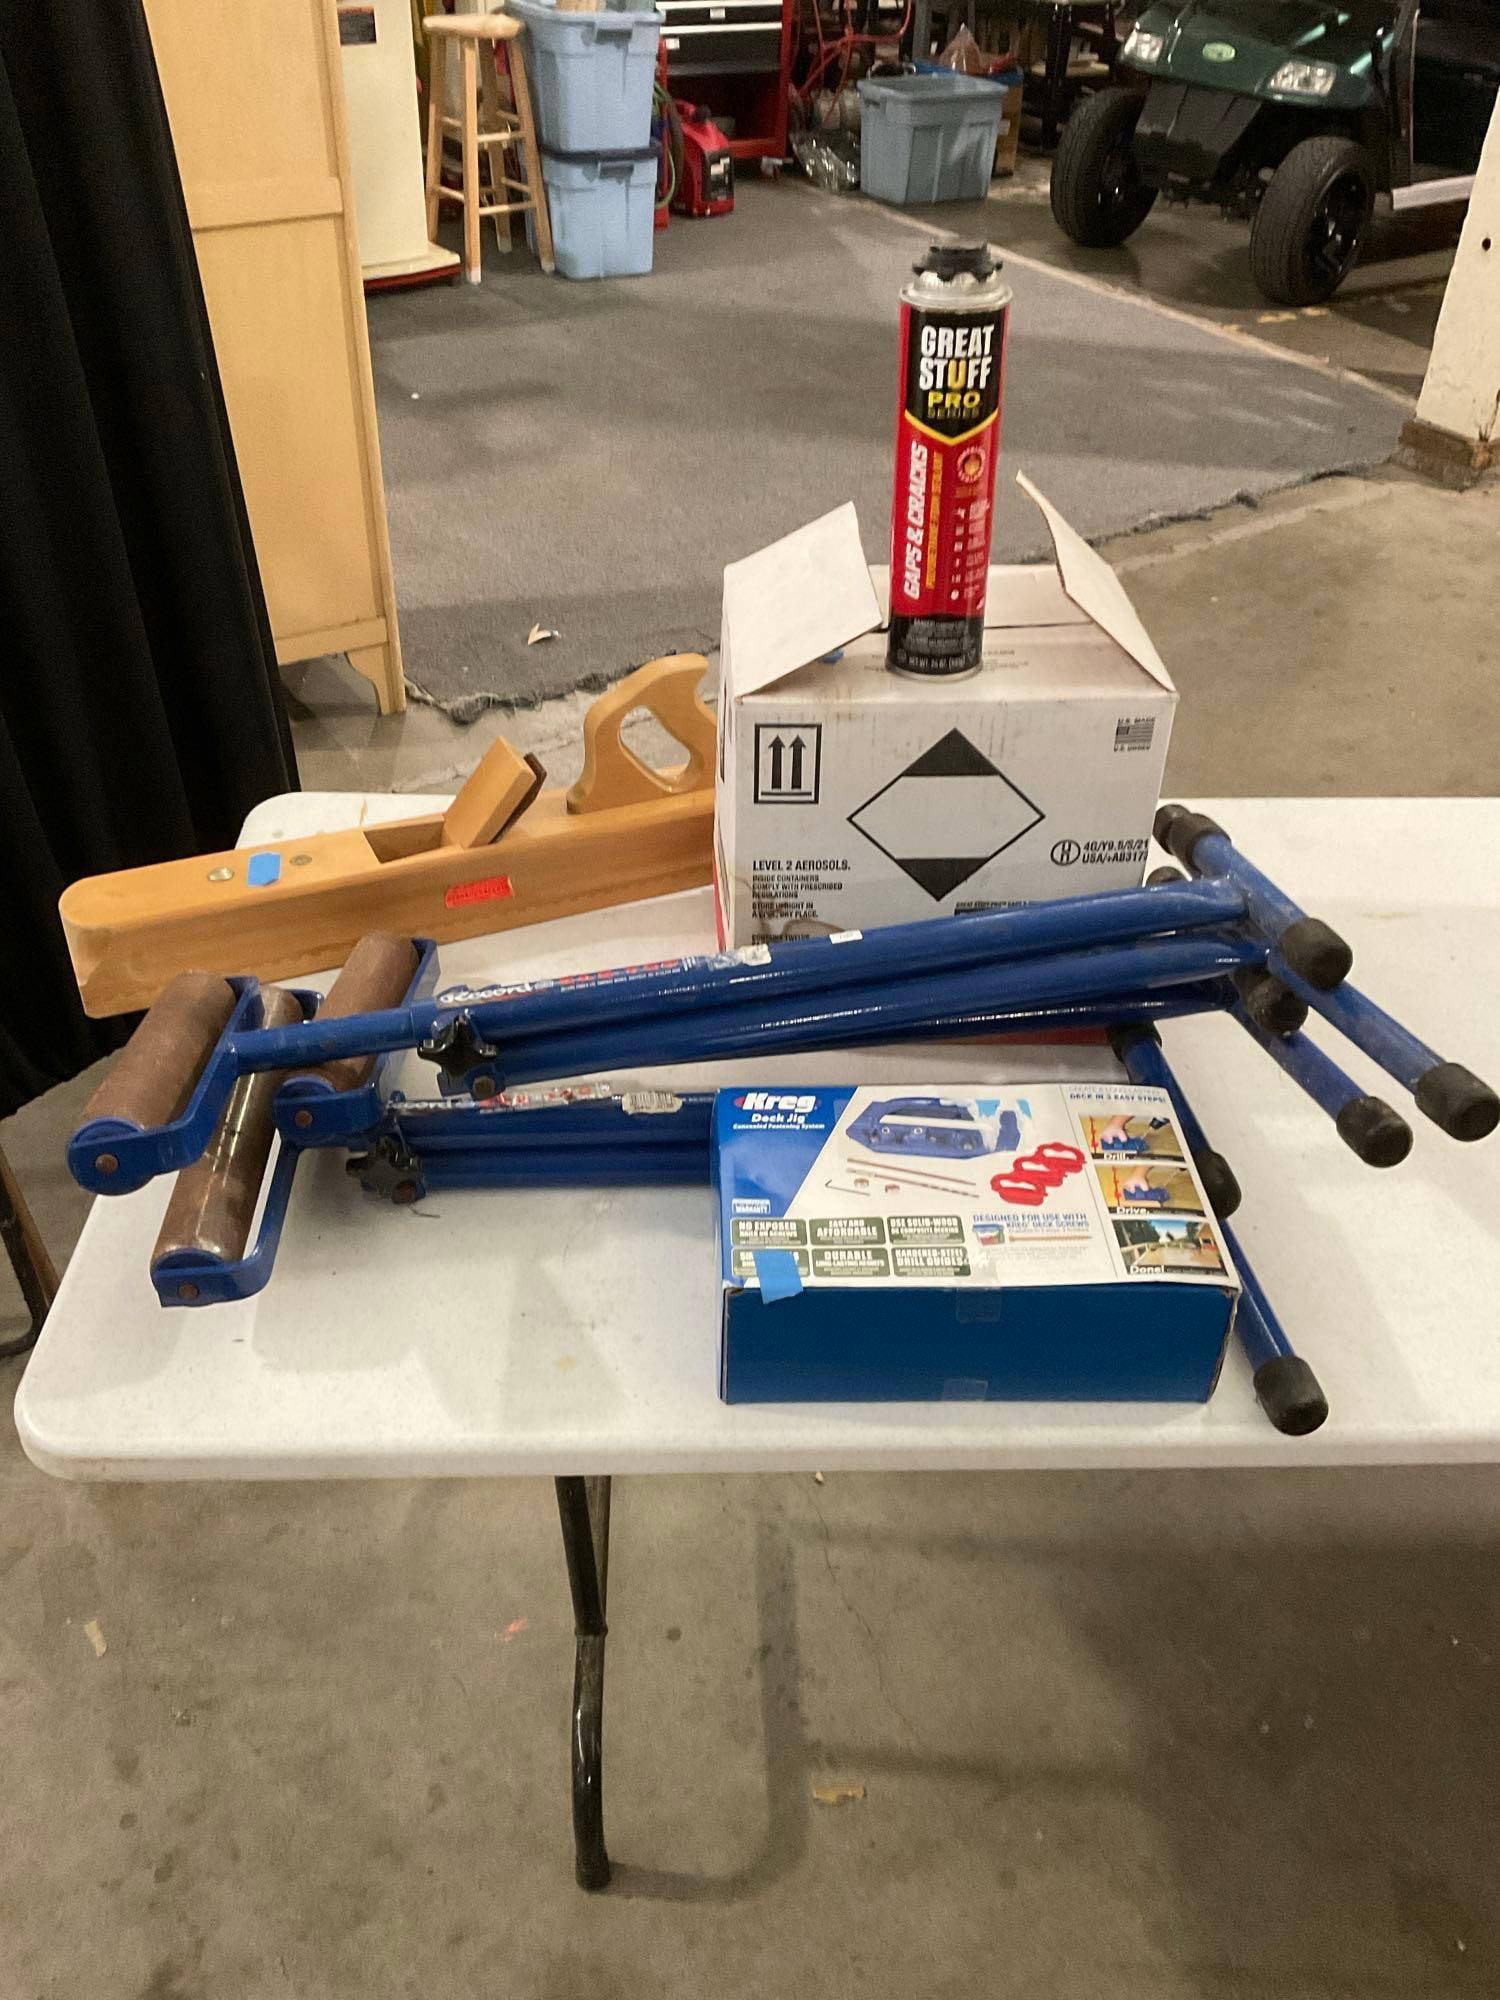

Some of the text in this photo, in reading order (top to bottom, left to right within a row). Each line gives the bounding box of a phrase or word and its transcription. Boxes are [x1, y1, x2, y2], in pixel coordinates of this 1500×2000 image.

[921, 324, 995, 357] GREAT
[919, 355, 993, 391] STUFF
[928, 391, 981, 408] PRO
[904, 440, 928, 600] GAPS & CRACKS
[752, 859, 851, 871] LEVEL 2 AEROSOLS.
[776, 874, 819, 882] CONTAINERS
[752, 882, 843, 891] COMPLY WITH PRESCRIBED
[742, 1092, 816, 1113] Kreg
[1137, 1094, 1166, 1102] STEPS!
[752, 1113, 806, 1125] Deck Jig
[890, 1217, 958, 1227] USE SOLID-WOOD
[973, 1214, 1019, 1222] DESIGNED
[1042, 1213, 1059, 1221] USE
[1062, 1212, 1087, 1221] WITH
[739, 1221, 797, 1231] NO EXPOSED
[828, 1219, 865, 1228] EASY AND
[1056, 1220, 1090, 1228] SCREWS
[816, 1227, 877, 1237] AFFORDABLE
[824, 1250, 873, 1261] DURABLE
[897, 1256, 925, 1266] DRILL
